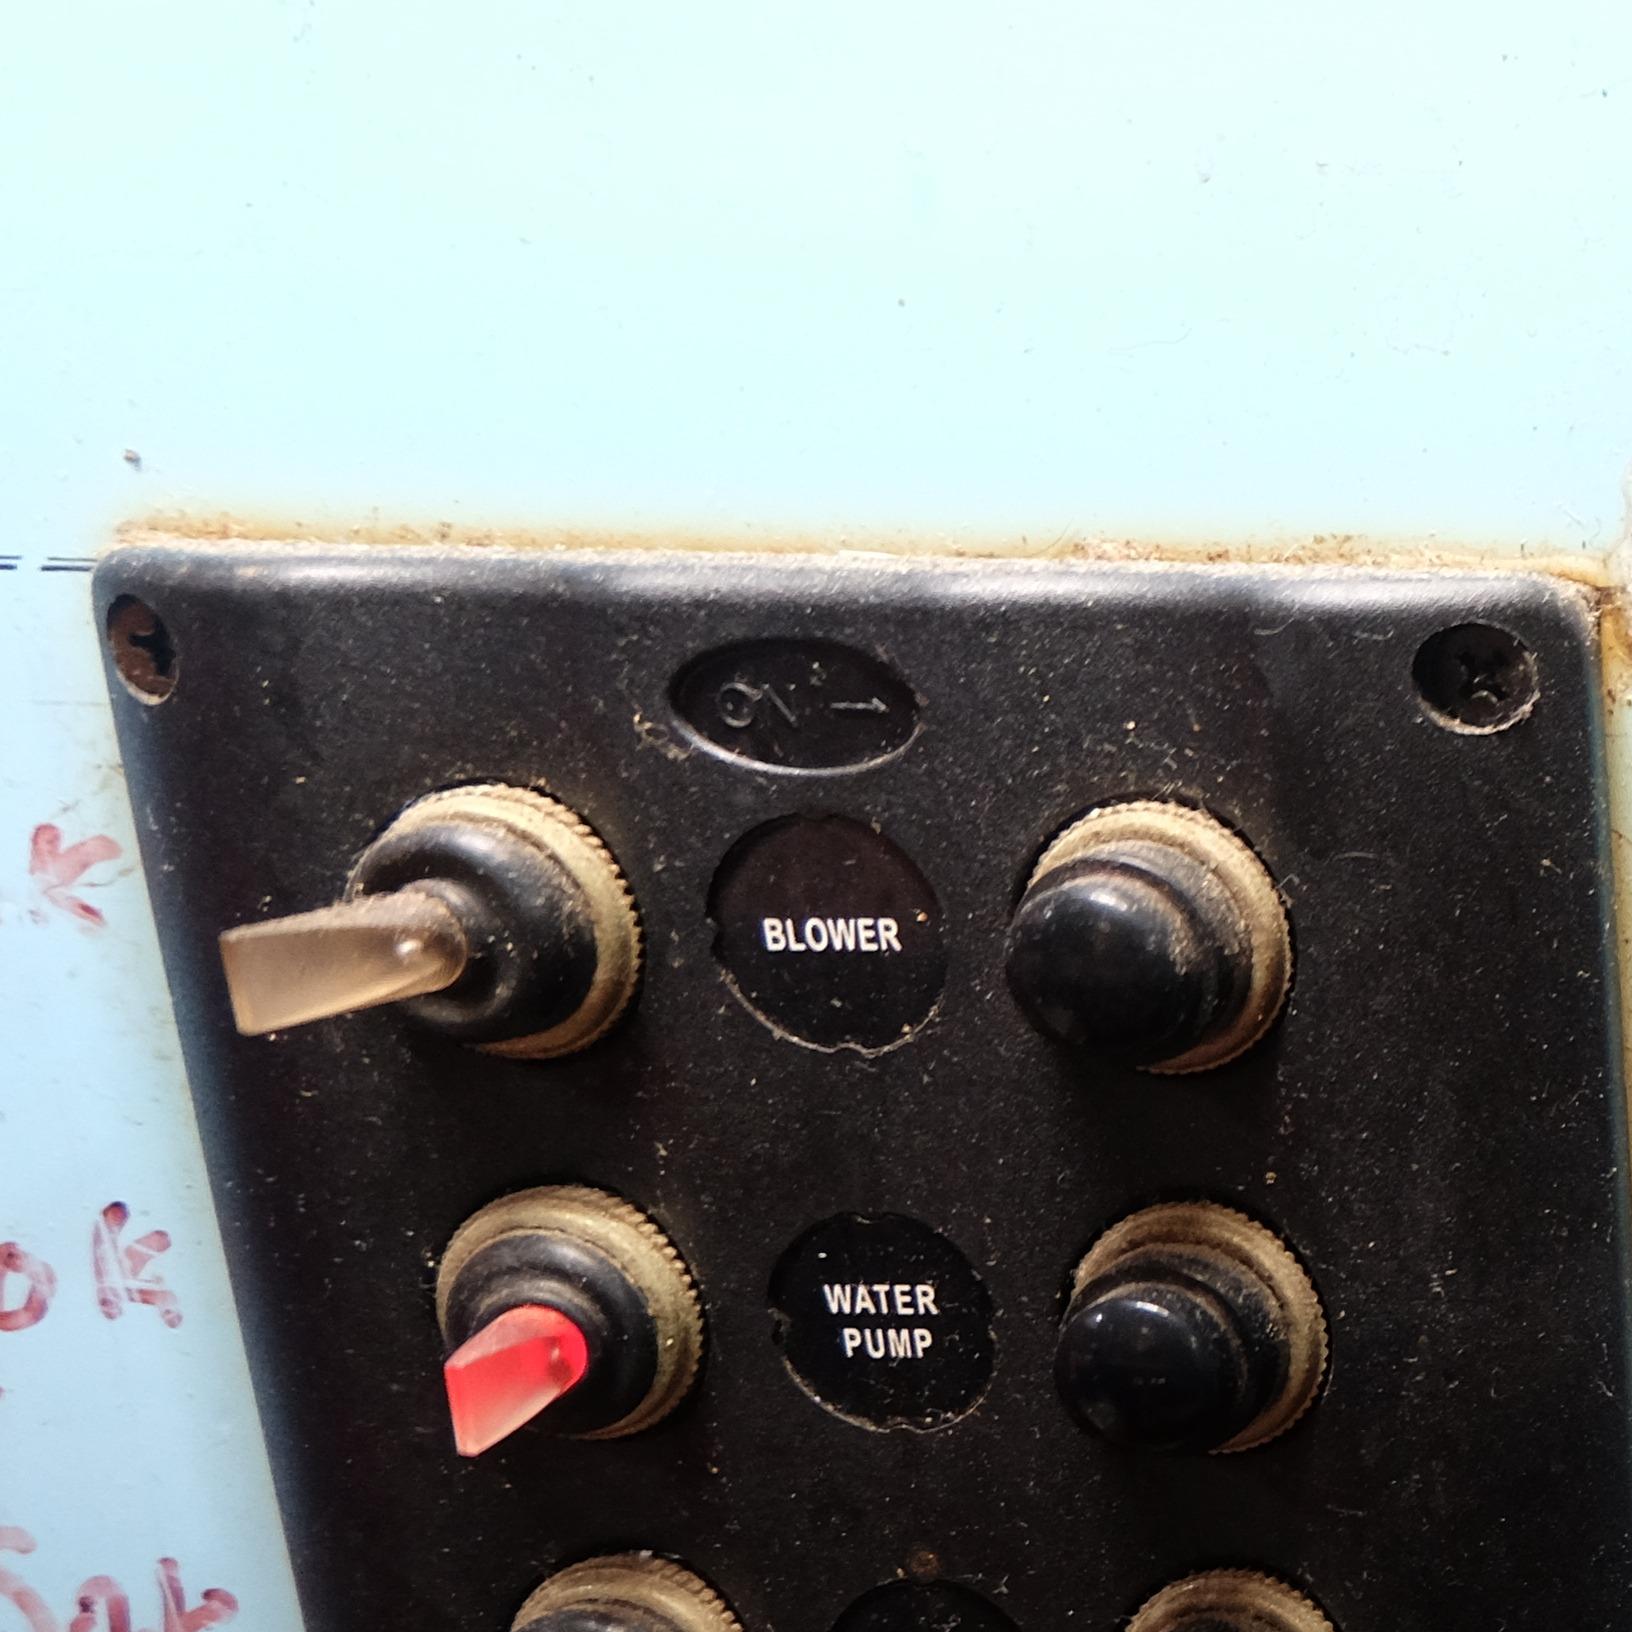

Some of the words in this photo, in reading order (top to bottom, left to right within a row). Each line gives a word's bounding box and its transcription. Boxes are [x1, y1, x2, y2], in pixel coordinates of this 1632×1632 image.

[761, 916, 903, 953] BLOWER
[822, 1282, 940, 1316] WATER
[841, 1326, 934, 1360] PUMP
